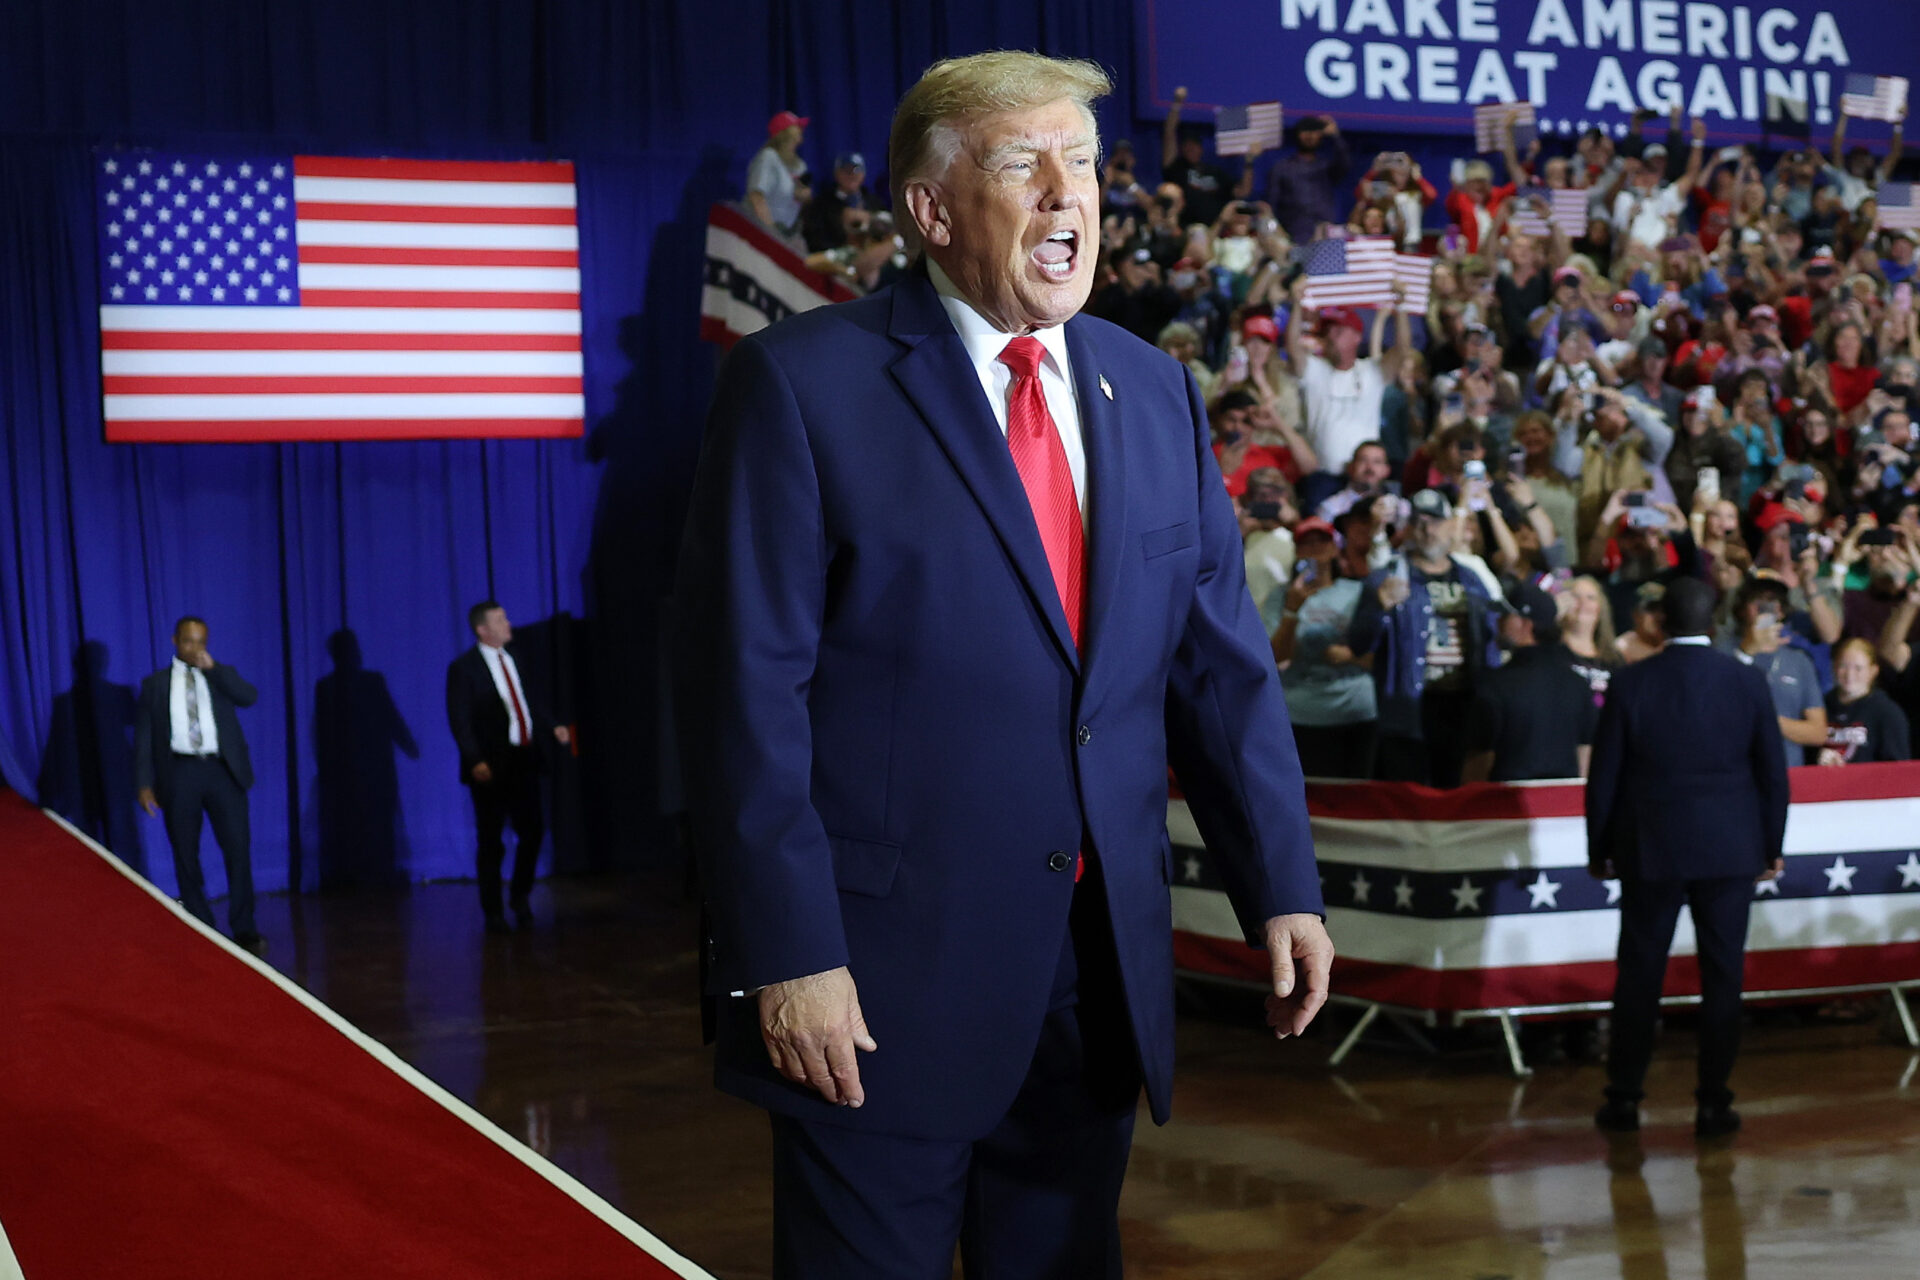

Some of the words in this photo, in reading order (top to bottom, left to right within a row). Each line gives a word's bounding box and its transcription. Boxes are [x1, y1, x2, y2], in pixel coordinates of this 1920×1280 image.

[1281, 0, 1499, 42] MAKE
[1526, 0, 1850, 66] AMERICA
[1304, 38, 1557, 107] GREAT
[1585, 56, 1832, 124] AGAIN!
